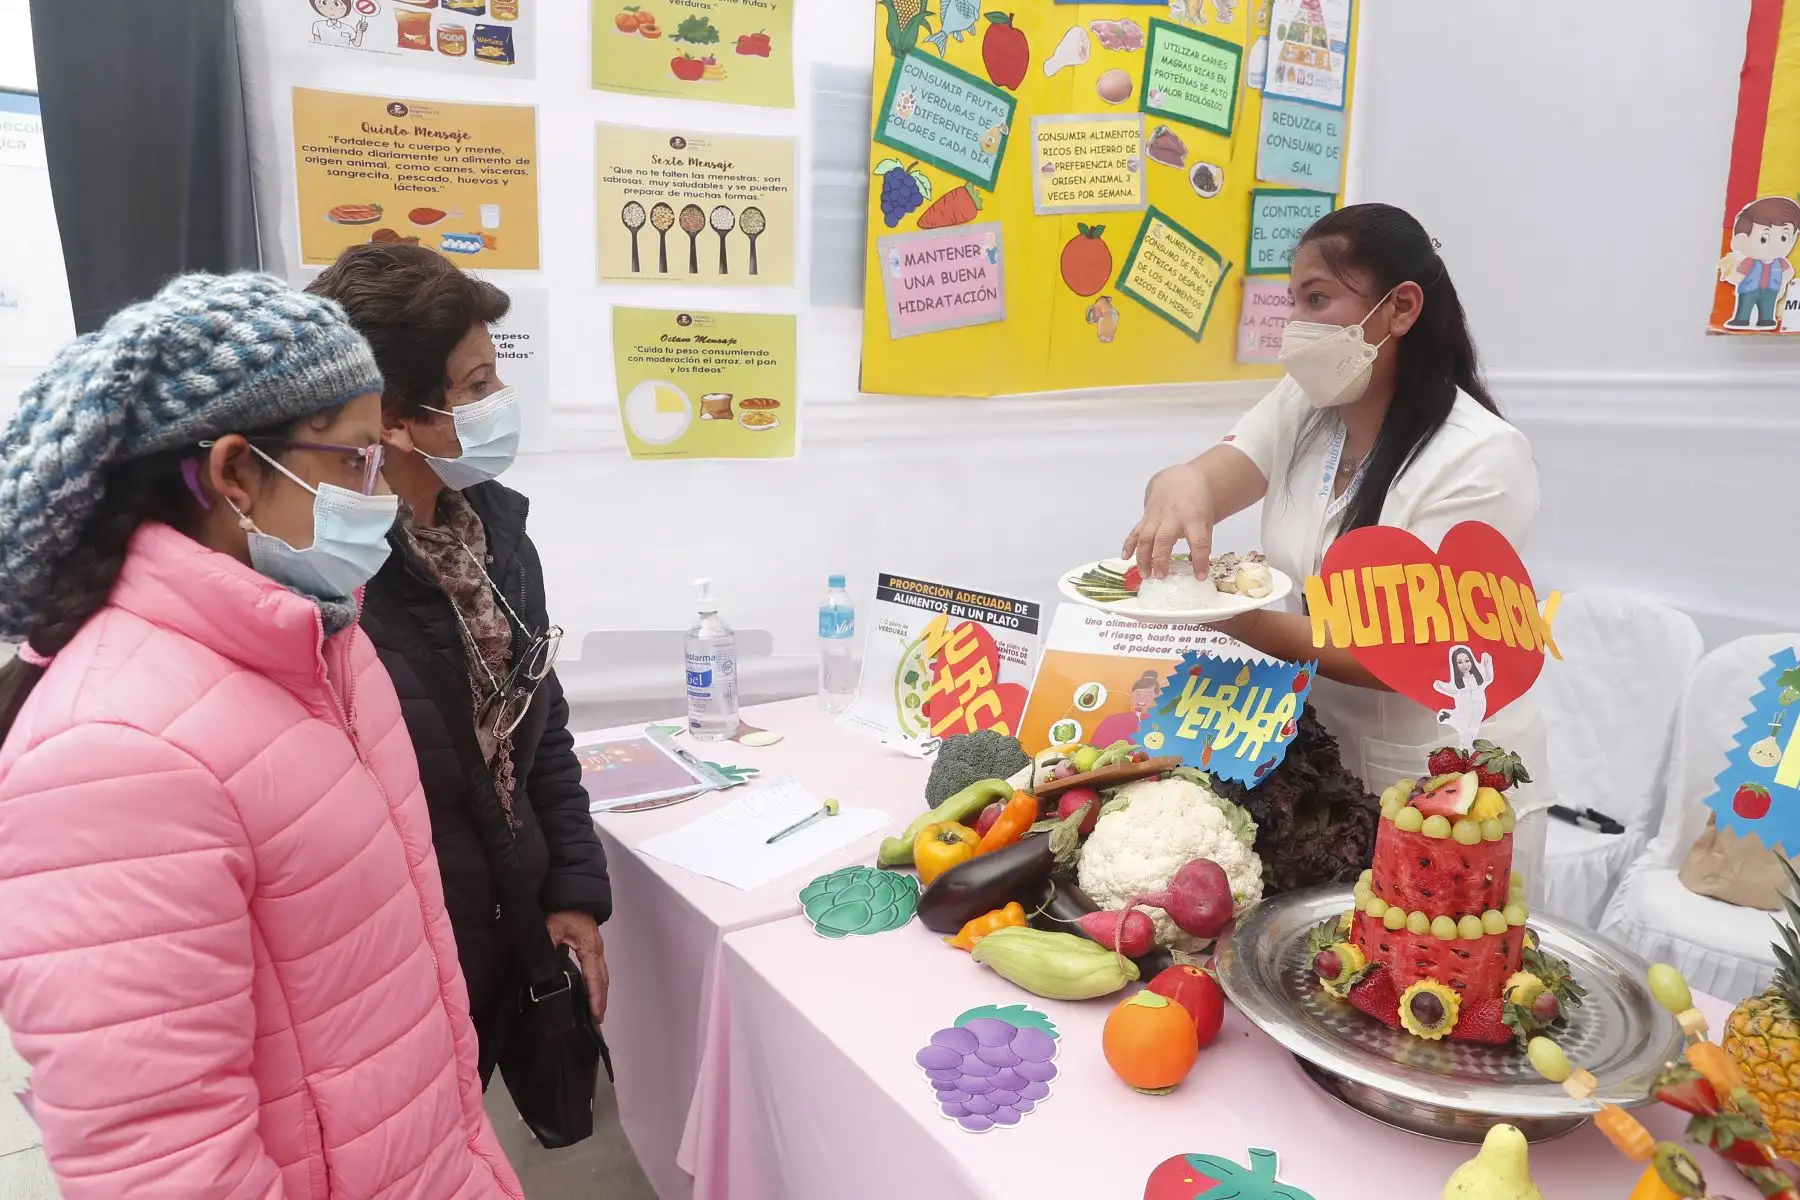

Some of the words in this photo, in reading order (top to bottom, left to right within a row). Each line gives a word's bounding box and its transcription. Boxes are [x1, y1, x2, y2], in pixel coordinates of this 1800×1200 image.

[1164, 42, 1200, 59] UTILIZAR
[1161, 56, 1192, 72] MAGRAS
[1194, 68, 1215, 79] RICAS
[1217, 76, 1226, 84] EN
[904, 64, 962, 97] CONSUMIR
[966, 92, 1004, 117] FRUTAS
[1155, 69, 1197, 88] PROTEÍNAS
[1200, 84, 1208, 92] DE
[1211, 88, 1228, 99] ALTO
[1159, 84, 1182, 97] VALOR
[911, 85, 917, 93] Y
[921, 90, 975, 121] VERDURAS
[979, 117, 992, 129] DE
[361, 122, 408, 135] Quinto
[414, 126, 471, 140] Mensaje
[914, 107, 979, 142] DIFERENTES
[1272, 112, 1321, 132] REDUZCA
[1326, 123, 1337, 137] EL
[888, 114, 936, 141] COLORES
[940, 137, 966, 155] CADA
[1038, 131, 1086, 141] CONSUMIR
[1090, 130, 1139, 139] ALIMENTOS
[302, 145, 363, 157] comiendo
[368, 150, 438, 161] diariamente
[462, 155, 511, 165] alimento
[516, 157, 530, 165] de
[395, 141, 405, 149] tu
[409, 143, 450, 152] cuerpo
[1044, 147, 1071, 156] RICOS
[1075, 147, 1086, 155] EN
[1090, 146, 1122, 154] HIERRO
[1126, 145, 1136, 153] DE
[1267, 134, 1322, 155] CONSUMO
[1326, 146, 1339, 159] DE
[305, 155, 343, 166] origen
[347, 158, 389, 169] animal,
[434, 165, 475, 174] carnes,
[652, 155, 684, 167] Sexto
[689, 157, 735, 172] Mensaje
[1055, 160, 1112, 170] PREFERENCIA
[1117, 160, 1126, 168] DE
[1291, 161, 1312, 175] SAL
[327, 169, 392, 181] sangrecita,
[398, 173, 452, 184] pescado,
[458, 176, 499, 185] huevos
[502, 178, 508, 186] y
[651, 169, 660, 177] te
[663, 170, 689, 179] falten
[692, 171, 705, 179] las
[1052, 176, 1086, 186] ORIGEN
[1090, 175, 1122, 184] ANIMAL
[1126, 174, 1130, 182] 3
[649, 179, 669, 188] muy
[673, 180, 723, 190] saludables
[624, 188, 663, 197] preparar
[684, 191, 721, 199] muchas
[1048, 192, 1074, 200] VECES
[1078, 190, 1094, 199] POR
[1263, 206, 1321, 218] CONTROLE
[1254, 227, 1267, 240] EL
[904, 244, 981, 267] MANTENER
[1165, 234, 1196, 260] AUMENTE
[1198, 256, 1204, 266] EL
[1259, 249, 1273, 261] DE
[1145, 236, 1179, 262] CONSUMO
[1180, 258, 1189, 270] DE
[1190, 267, 1212, 288] FRUTAS
[904, 274, 935, 290] UNA
[941, 267, 986, 285] BUENA
[1138, 262, 1148, 273] DE
[1149, 269, 1162, 283] LOS
[1165, 280, 1202, 309] ALIMENTOS
[899, 285, 997, 315] HIDRATACIÓN
[1134, 276, 1157, 295] RICOS
[1158, 290, 1168, 302] EN
[1170, 299, 1193, 319] HIERRO
[661, 334, 690, 343] Octavo
[694, 336, 737, 345] Mensaje
[646, 355, 700, 363] moderación
[677, 348, 698, 356] peso
[702, 348, 769, 357] consumiendo
[890, 578, 953, 599] PROPORCIÓN
[956, 592, 1011, 611] ADECUADA
[1015, 604, 1028, 615] DE
[894, 593, 948, 612] ALIMENTOS
[951, 605, 964, 616] EN
[968, 609, 983, 620] UN
[987, 614, 1019, 627] PLATO
[1305, 563, 1564, 660] NUTRICION
[1085, 618, 1102, 626] Una
[1111, 631, 1143, 641] riesgo,
[1147, 633, 1175, 642] hasta
[1128, 644, 1172, 654] padecer
